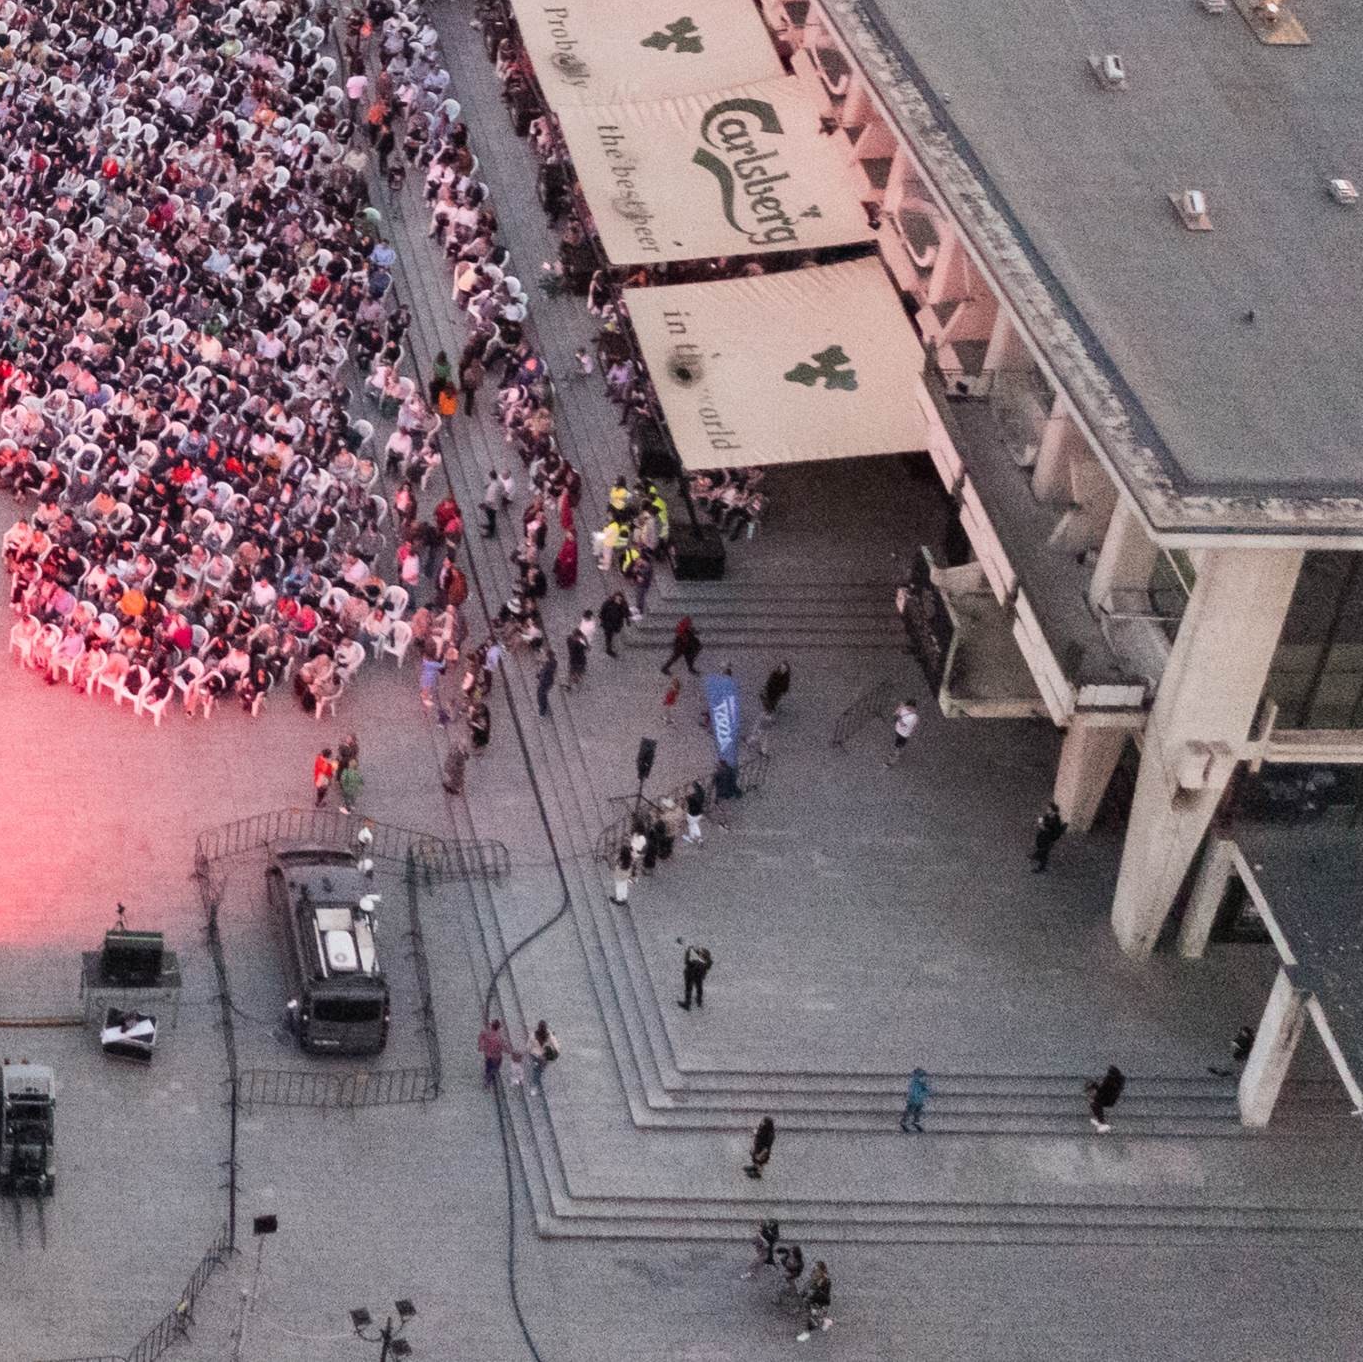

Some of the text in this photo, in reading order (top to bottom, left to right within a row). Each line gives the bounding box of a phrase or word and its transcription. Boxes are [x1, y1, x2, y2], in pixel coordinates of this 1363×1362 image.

[597, 125, 625, 159] the
[612, 165, 648, 211] best
[631, 213, 661, 253] beer
[691, 97, 799, 245] Carlsberg
[663, 311, 691, 334] in
[674, 343, 704, 383] th
